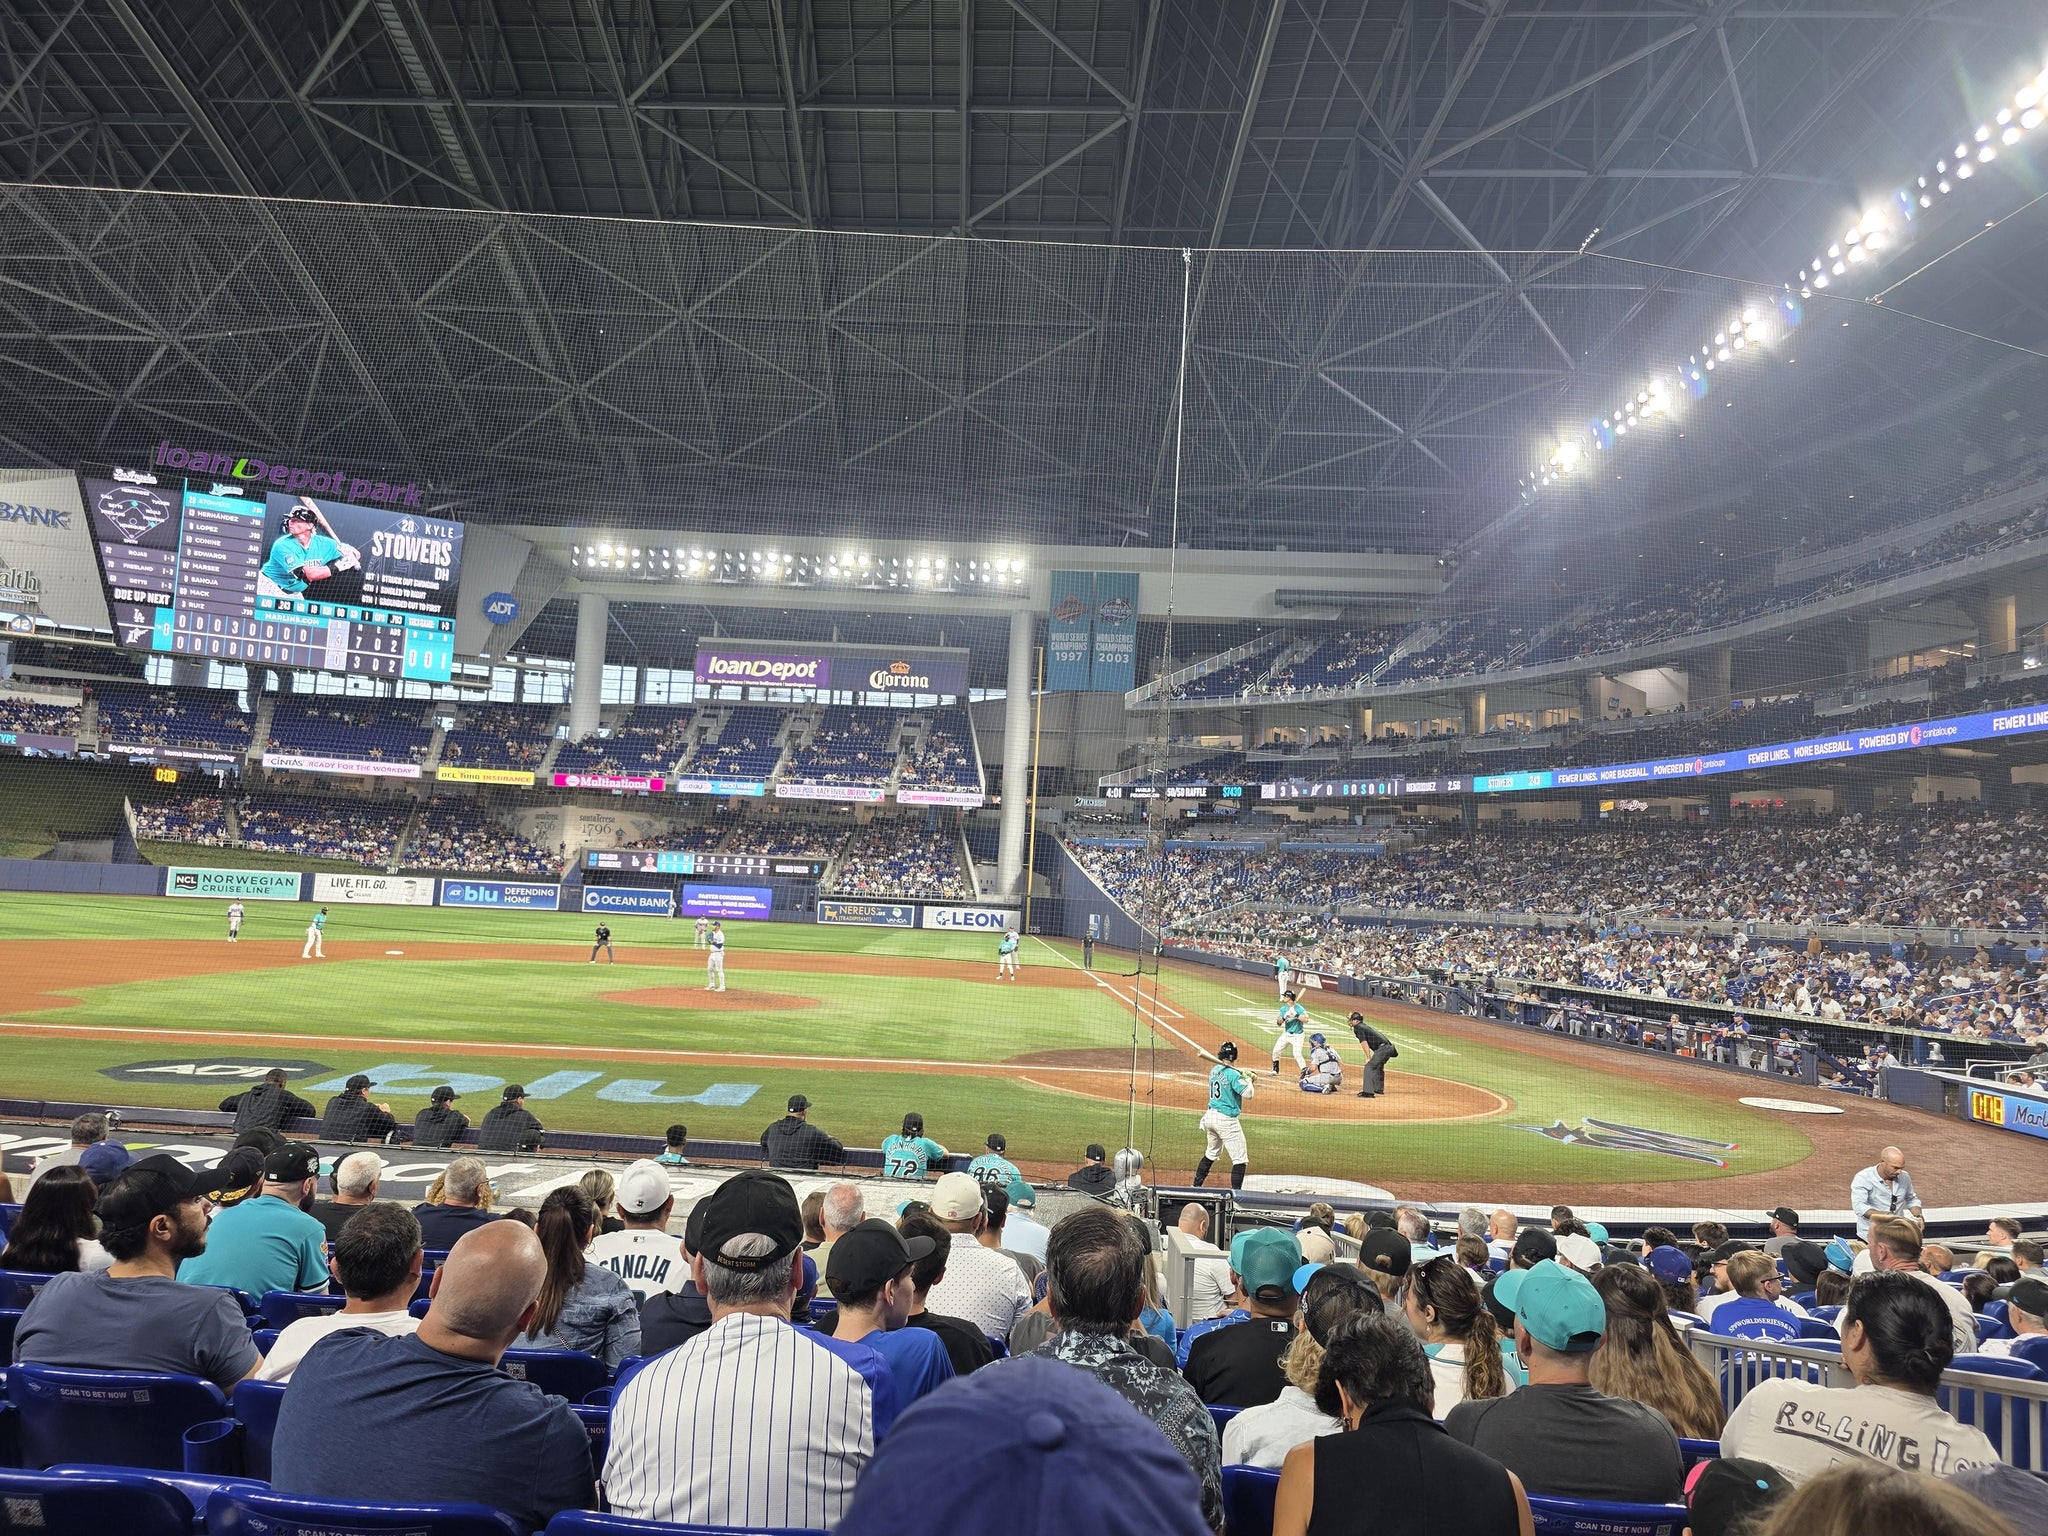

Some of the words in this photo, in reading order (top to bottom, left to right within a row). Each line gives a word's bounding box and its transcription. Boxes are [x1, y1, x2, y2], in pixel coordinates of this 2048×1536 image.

[155, 440, 346, 494] loanDepot
[348, 477, 425, 507] park
[0, 502, 71, 529] BANK
[425, 524, 454, 538] KYLE
[372, 531, 452, 566] STOWERS
[435, 567, 450, 581] DH
[114, 588, 133, 601] DUE
[133, 590, 147, 602] UP
[147, 592, 170, 606] NEXT
[190, 588, 210, 597] MACK
[488, 601, 515, 615] ADT
[12, 619, 29, 629] 42
[179, 615, 186, 628] 0
[196, 617, 203, 630] 0
[214, 619, 221, 632] 0
[232, 621, 238, 634] 3
[249, 623, 256, 637] 0
[266, 625, 273, 638] 0
[284, 627, 290, 640] 0
[300, 629, 307, 642] 0
[336, 634, 342, 646] 3
[356, 636, 362, 649] 7
[374, 638, 381, 651] 0
[391, 640, 397, 653] 2
[1051, 633, 1069, 641] WORLD
[1070, 633, 1088, 641] SERIES
[1096, 634, 1115, 642] WORLD
[1051, 642, 1087, 650] CHAMPIONS
[1096, 643, 1133, 652] CHAMPIONS
[177, 636, 184, 649] 0
[194, 638, 201, 651] 0
[212, 640, 219, 653] 0
[230, 642, 236, 655] 0
[247, 644, 254, 657] 0
[264, 646, 271, 659] 0
[281, 648, 288, 660] 0
[333, 655, 340, 667] 0
[354, 656, 360, 669] 3
[372, 658, 379, 671] 0
[388, 660, 395, 673] 2
[1055, 652, 1082, 661] 1997
[1099, 653, 1129, 663] 2003
[708, 656, 817, 680] loanDepot
[869, 670, 929, 691] Corona
[1993, 716, 2025, 731] FEWER
[108, 743, 156, 755] loanDepot
[1748, 753, 1769, 764] FEWER
[1770, 750, 1790, 762] LINES.
[1794, 747, 1813, 758] MORE
[1814, 741, 1853, 755] BASEBALL.
[1859, 735, 1896, 749] POWERED
[1898, 733, 1910, 745] BY
[1923, 726, 1957, 738] cantaloupe
[337, 762, 353, 771] FOR
[355, 763, 371, 772] THE
[1558, 774, 1578, 783] FEWER
[1579, 772, 1598, 782] LINES.
[1600, 771, 1616, 780] MORE
[1617, 769, 1648, 780] BASEBALL.
[1653, 764, 1683, 775] POWERED
[1684, 763, 1693, 773] BY
[1703, 759, 1725, 770] cantaloupe
[482, 775, 532, 783] INSURANCE
[580, 777, 650, 789] Multinational
[1488, 778, 1513, 788] STOWERS
[1106, 787, 1122, 798] 4:01
[1185, 787, 1207, 797] RAFFLE
[1222, 786, 1242, 797] $7430
[1280, 786, 1286, 797] 3
[1327, 784, 1332, 795] 0
[1343, 784, 1348, 795] B
[1351, 784, 1357, 795] 0
[1360, 784, 1366, 795] S
[1369, 783, 1374, 794] 0
[582, 823, 612, 836] 1796
[176, 876, 196, 884] NCL
[202, 874, 294, 886] NORWEGIAN
[331, 878, 354, 888] LIVE.
[355, 879, 371, 889] FIT.
[373, 880, 388, 890] GO.
[202, 885, 243, 893] CRUISE
[465, 886, 498, 903] blu
[504, 887, 554, 897] DEFENDING
[504, 895, 531, 904] HOME
[601, 895, 637, 906] OCEAN
[639, 897, 669, 908] BANK
[840, 905, 876, 916] NEREUS
[886, 917, 907, 925] VANDA
[952, 912, 1004, 928] LEON
[1029, 926, 1041, 934] 335
[1210, 1080, 1221, 1099] 13
[890, 1159, 918, 1177] 72
[717, 1255, 734, 1267] DESERT
[734, 1260, 757, 1268] STORM
[60, 1388, 80, 1397] SCAN
[1574, 1521, 1598, 1530] SCAN
[1613, 1525, 1629, 1533] BET
[1631, 1526, 1651, 1534] NOW
